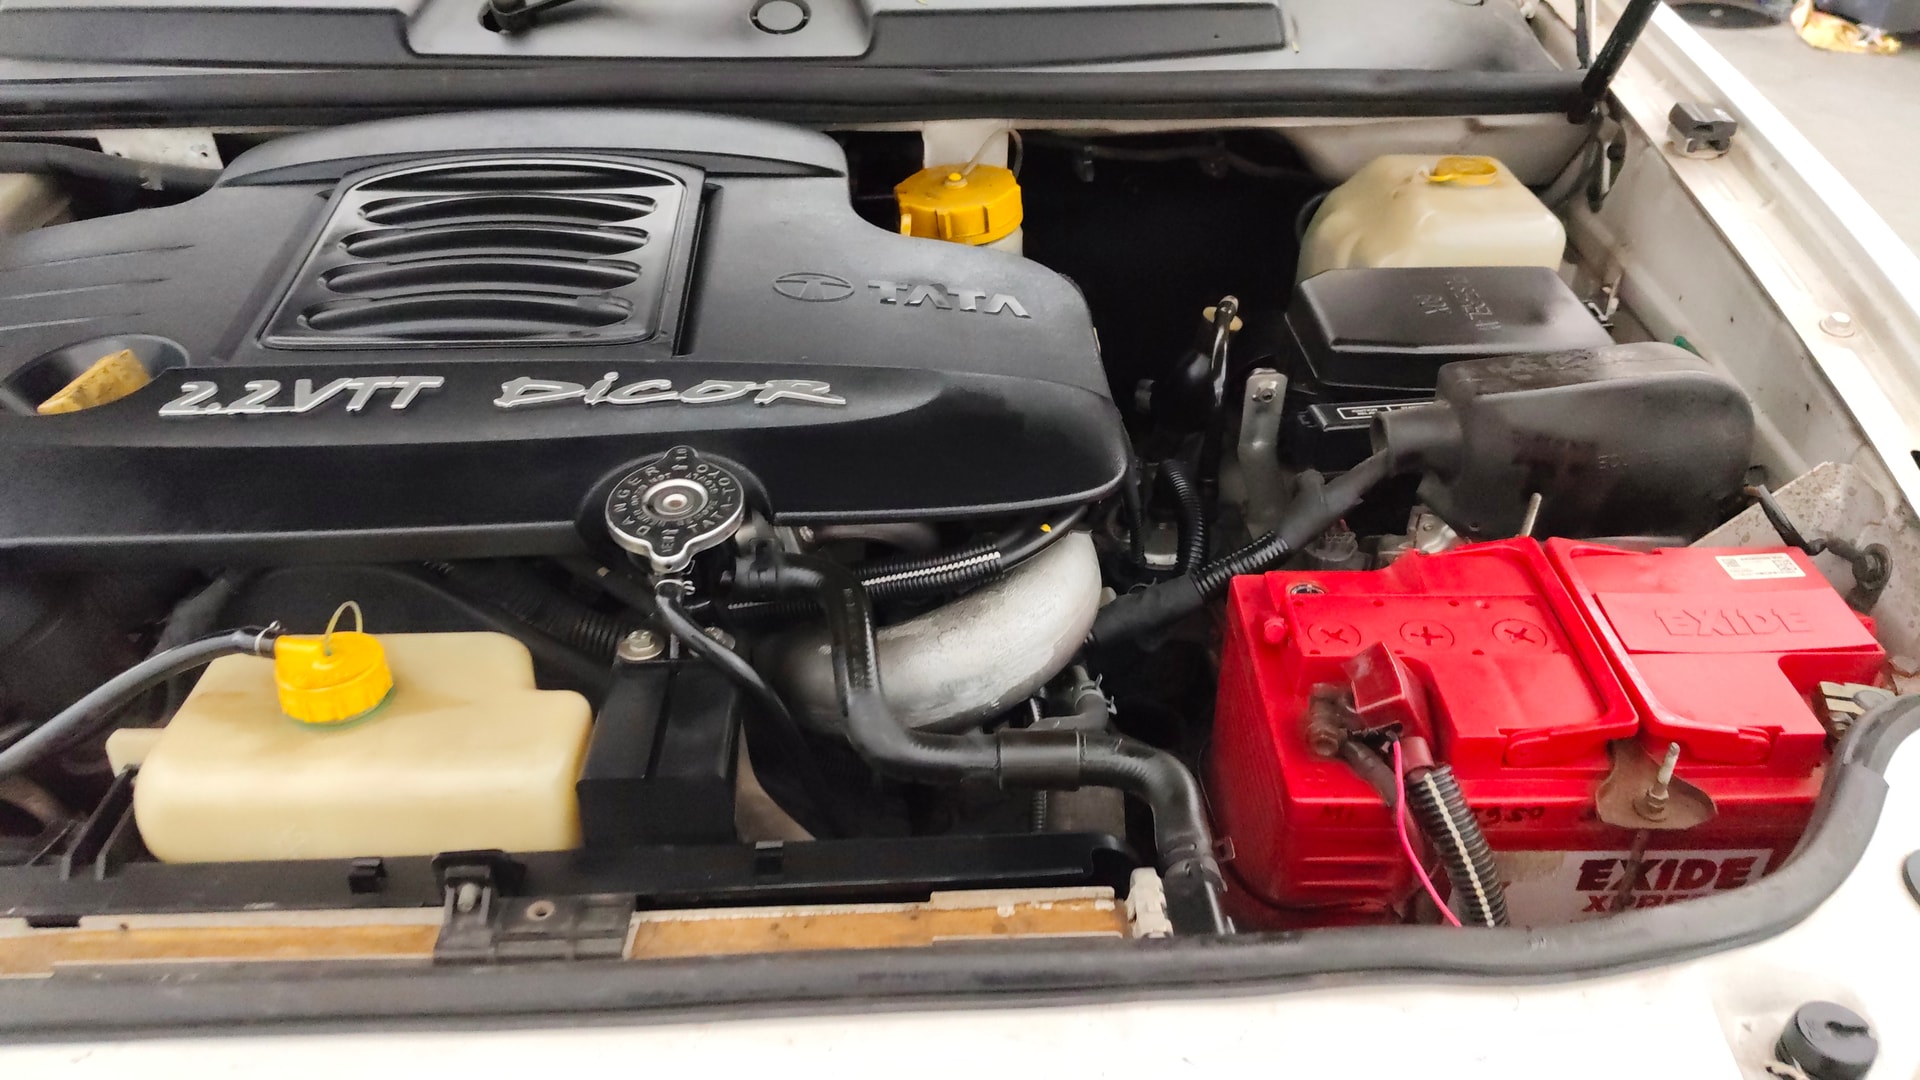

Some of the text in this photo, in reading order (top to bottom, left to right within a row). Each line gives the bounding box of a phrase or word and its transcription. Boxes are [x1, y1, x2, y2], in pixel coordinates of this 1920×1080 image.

[866, 279, 1032, 318] TATA
[613, 465, 660, 536] DANGER
[1653, 608, 1815, 637] EXIDE
[1575, 857, 1758, 890] EXIDE
